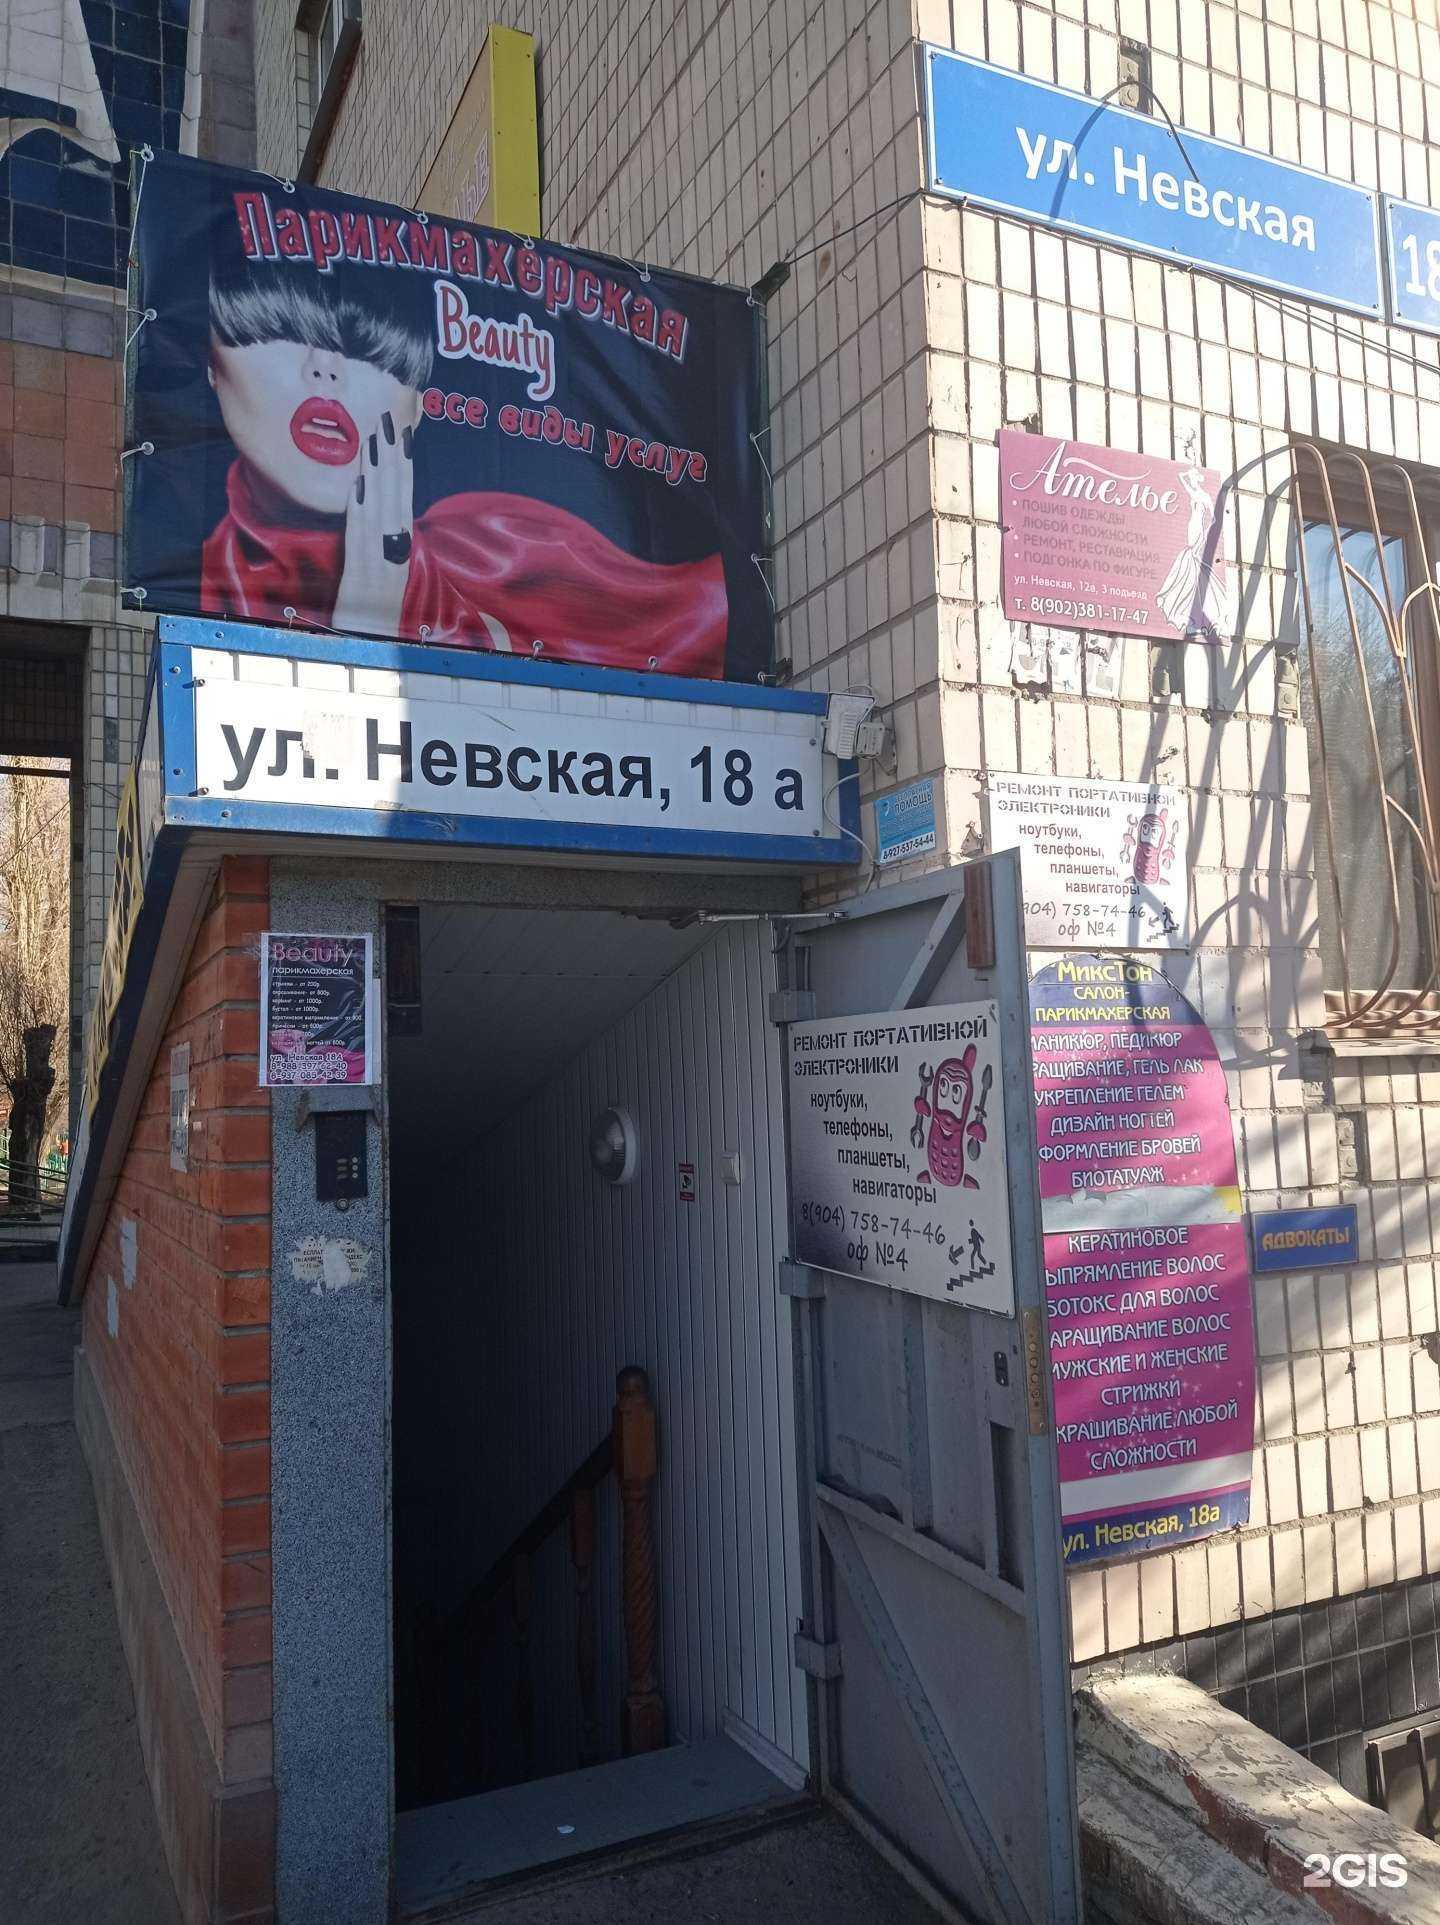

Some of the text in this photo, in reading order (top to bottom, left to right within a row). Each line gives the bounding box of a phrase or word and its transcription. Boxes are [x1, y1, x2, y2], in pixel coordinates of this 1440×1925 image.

[1015, 126, 1317, 252] ул. Невская
[232, 192, 688, 362] Парикмахерская
[437, 283, 553, 398] Beauty
[421, 388, 708, 486] все виды услуг
[1009, 440, 1180, 515] Ателье
[1022, 499, 1126, 525] ПОШИВ ОДЕЖДЫ
[1023, 516, 1149, 546] ЛЮБОЙ СЛОЖНОСТИ
[1023, 534, 1161, 564] РЕМОНТ, РЕСТАВРАЦИЯ
[1023, 551, 1159, 581] ПОДГОНКА ПО ФИГУРЕ
[1014, 575, 1029, 586] ул.
[1031, 575, 1076, 592] Невская,
[1101, 584, 1108, 594] 3
[1030, 596, 1149, 625] 8(902)381-17-47
[220, 718, 803, 812] ул. Невская, 18 а
[996, 782, 1061, 798] РЕМОНТ
[998, 800, 1111, 818] ЭЛЕКТРОНИКИ
[1019, 823, 1082, 840] ноутбуки,
[1034, 843, 1104, 859] телефоны,
[1050, 863, 1119, 878] планшеты,
[1065, 882, 1140, 897] навигаторы
[1062, 903, 1146, 918] 758-74-46
[1058, 919, 1116, 942] оф №4
[273, 942, 353, 967] Beauty
[272, 967, 354, 977] парикмахерская
[1058, 962, 1152, 982] МиксТон
[1074, 986, 1130, 1000] САЛОН-
[1036, 1006, 1170, 1022] ПАРИКМАХЕРСКАЯ
[793, 1015, 988, 1052] РЕМОНТ ПОРТАТИВНОЙ
[1111, 1032, 1182, 1051] ПЕДИКЮР
[288, 1053, 324, 1062] Невская
[794, 1055, 899, 1077] ЭЛЕКТРОНИКИ
[1133, 1060, 1170, 1075] ГЕЛЬ
[1173, 1059, 1204, 1074] ЛАК
[810, 1089, 868, 1112] ноутбуки,
[1034, 1085, 1184, 1107] УКРЕПЛЕНИЕ ГЕЛЕМ
[823, 1118, 893, 1142] телефоны,
[1051, 1109, 1175, 1136] ДИЗАЙН НОГТЕЙ
[837, 1148, 910, 1173] планшеты,
[1039, 1134, 1201, 1163] ФОРМЛЕНИЕ БРОВЕЙ
[852, 1176, 937, 1204] навигаторы
[1071, 1166, 1165, 1189] БИОТАТУАЖ
[801, 1202, 946, 1245] 8(904) 758-74-46
[1068, 1227, 1188, 1253] КЕРАТИНОВОЕ
[1262, 1227, 1349, 1251] АДВОКАТЫ
[847, 1235, 908, 1272] оф №4
[1046, 1253, 1226, 1286] ЫПРЯМЛЕНИЕ ВОЛОС
[1120, 1290, 1156, 1315] ДЛЯ
[1160, 1284, 1220, 1306] ВОЛОС
[1050, 1313, 1231, 1349] АРАЩИВАНИЕ ВОЛОС
[1135, 1353, 1146, 1371] И
[1151, 1343, 1228, 1368] ЖЕНСКИЕ
[1101, 1379, 1181, 1406] СТРИЖКИ
[1056, 1399, 1238, 1444] КРАШИВАНИЕ ЛЮБОЙ
[1090, 1438, 1197, 1471] СЛОЖНОСТИ
[1062, 1503, 1221, 1559] ул. Невская, 18а
